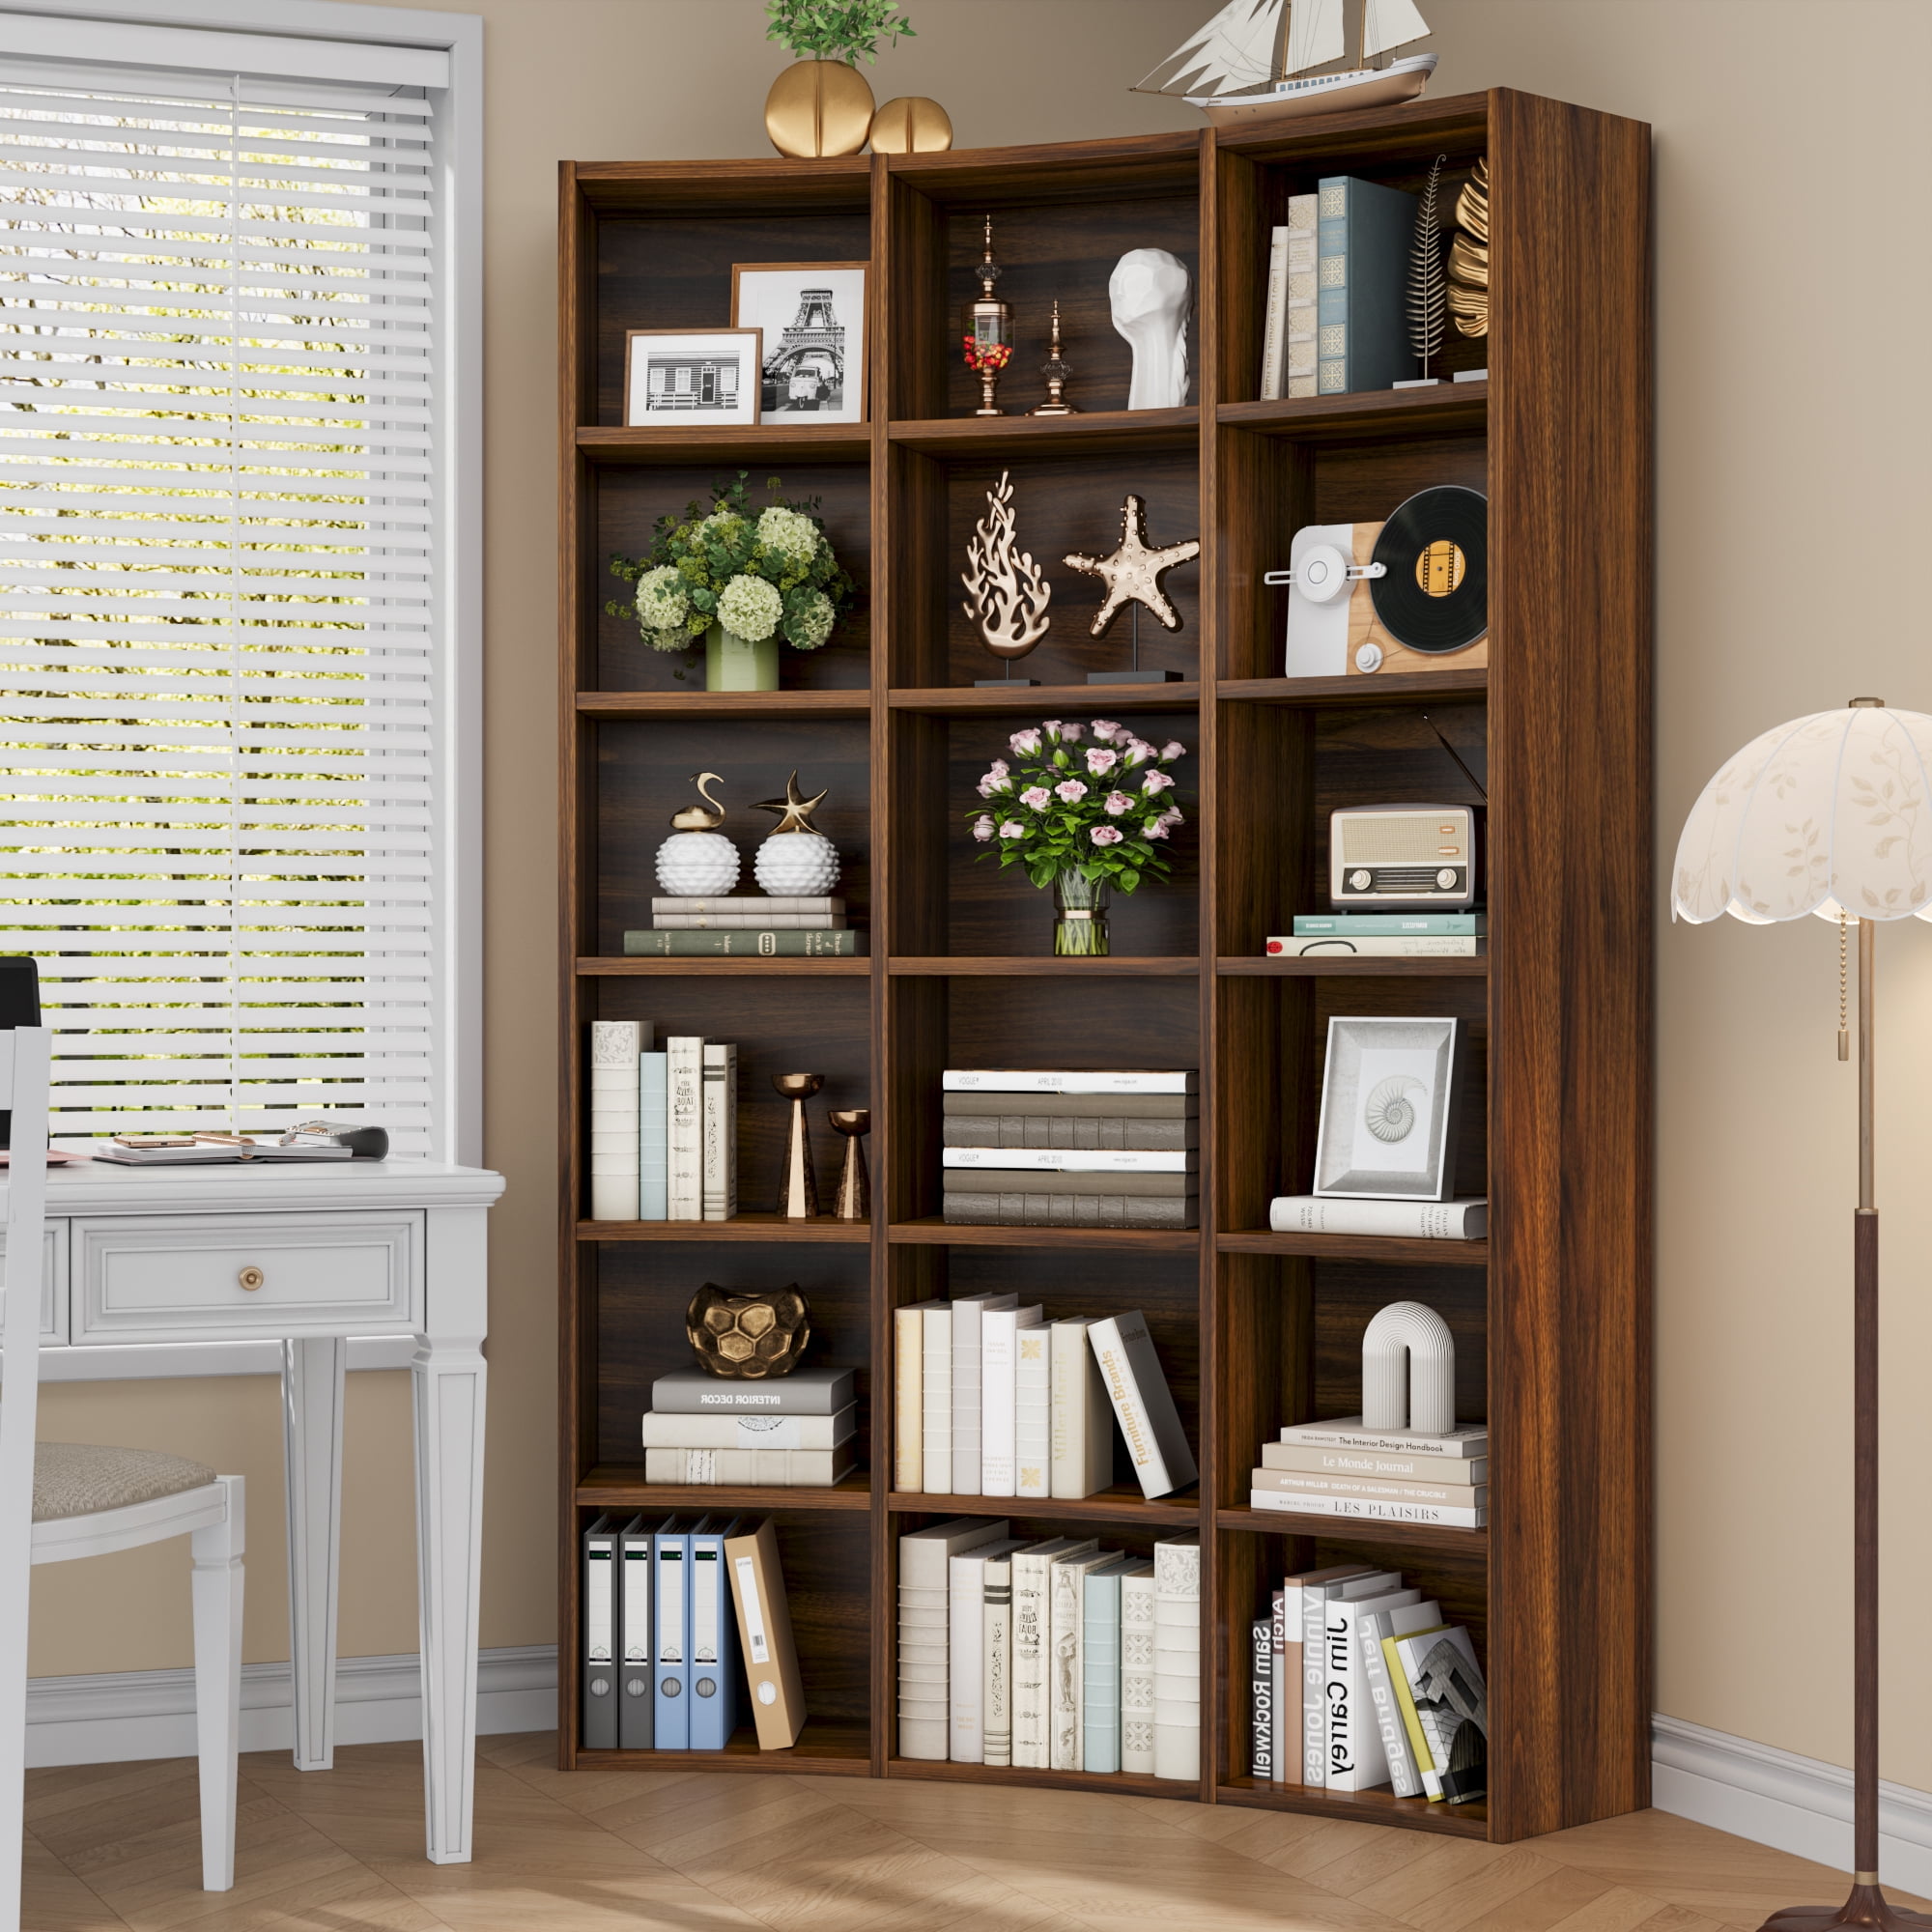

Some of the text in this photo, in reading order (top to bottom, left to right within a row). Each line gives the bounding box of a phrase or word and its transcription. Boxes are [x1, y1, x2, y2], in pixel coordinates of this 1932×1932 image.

[1102, 1350, 1149, 1467] Furniture Brands
[1054, 1410, 1067, 1462] Miller
[1339, 1437, 1444, 1453] The Interior Design Handbook
[1323, 1456, 1413, 1474] Le Monde Journal
[1279, 1478, 1328, 1490] ARTHUR MILLER
[1331, 1482, 1351, 1492] DEATH
[1366, 1485, 1399, 1495] SALESMAN
[1403, 1488, 1416, 1497] THE
[1416, 1490, 1447, 1499] CRUCIBLE
[1334, 1501, 1440, 1520] LES PLAISIRS
